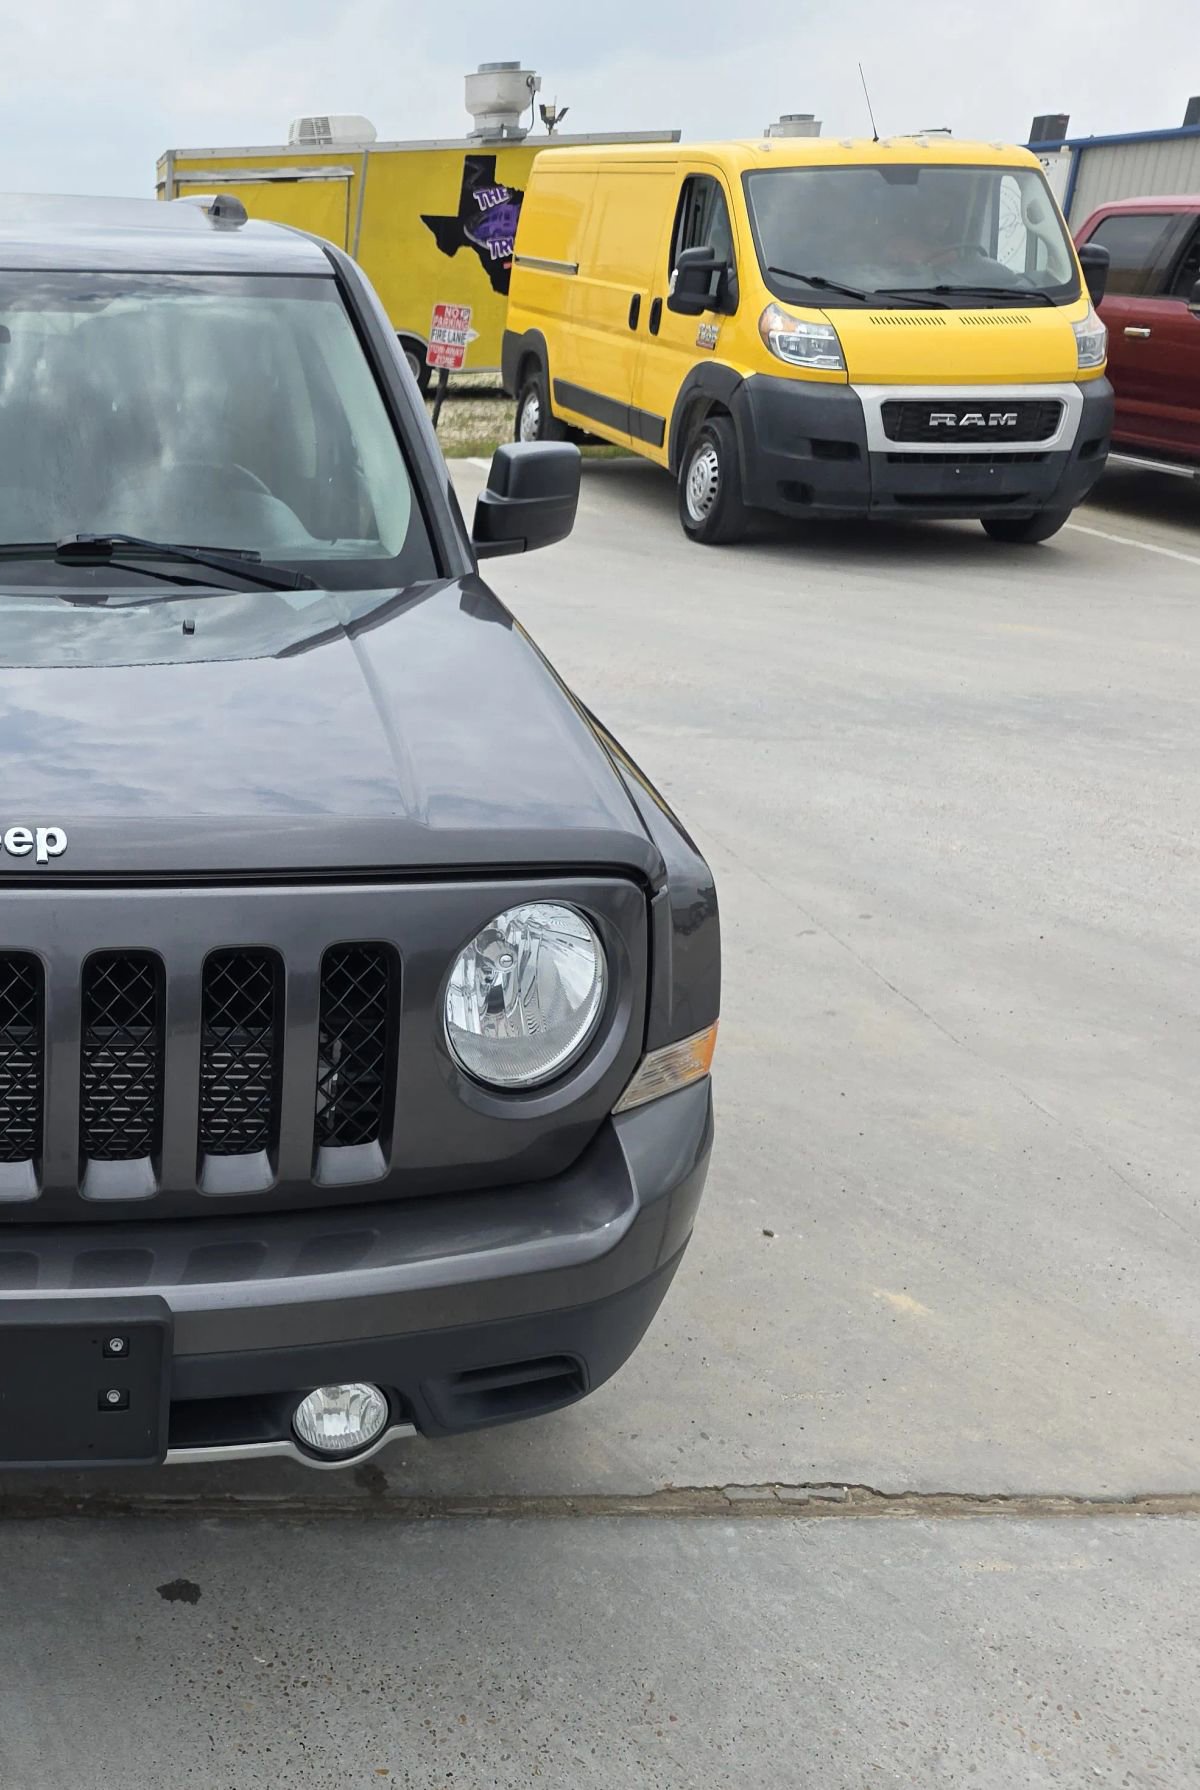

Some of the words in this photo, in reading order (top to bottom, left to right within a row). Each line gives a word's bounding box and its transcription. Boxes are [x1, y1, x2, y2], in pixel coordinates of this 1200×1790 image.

[473, 188, 510, 211] THE
[444, 306, 460, 319] NO
[433, 315, 469, 331] PARKING
[431, 328, 447, 343] FIRE
[447, 331, 467, 345] LANE
[929, 412, 1018, 427] RAM
